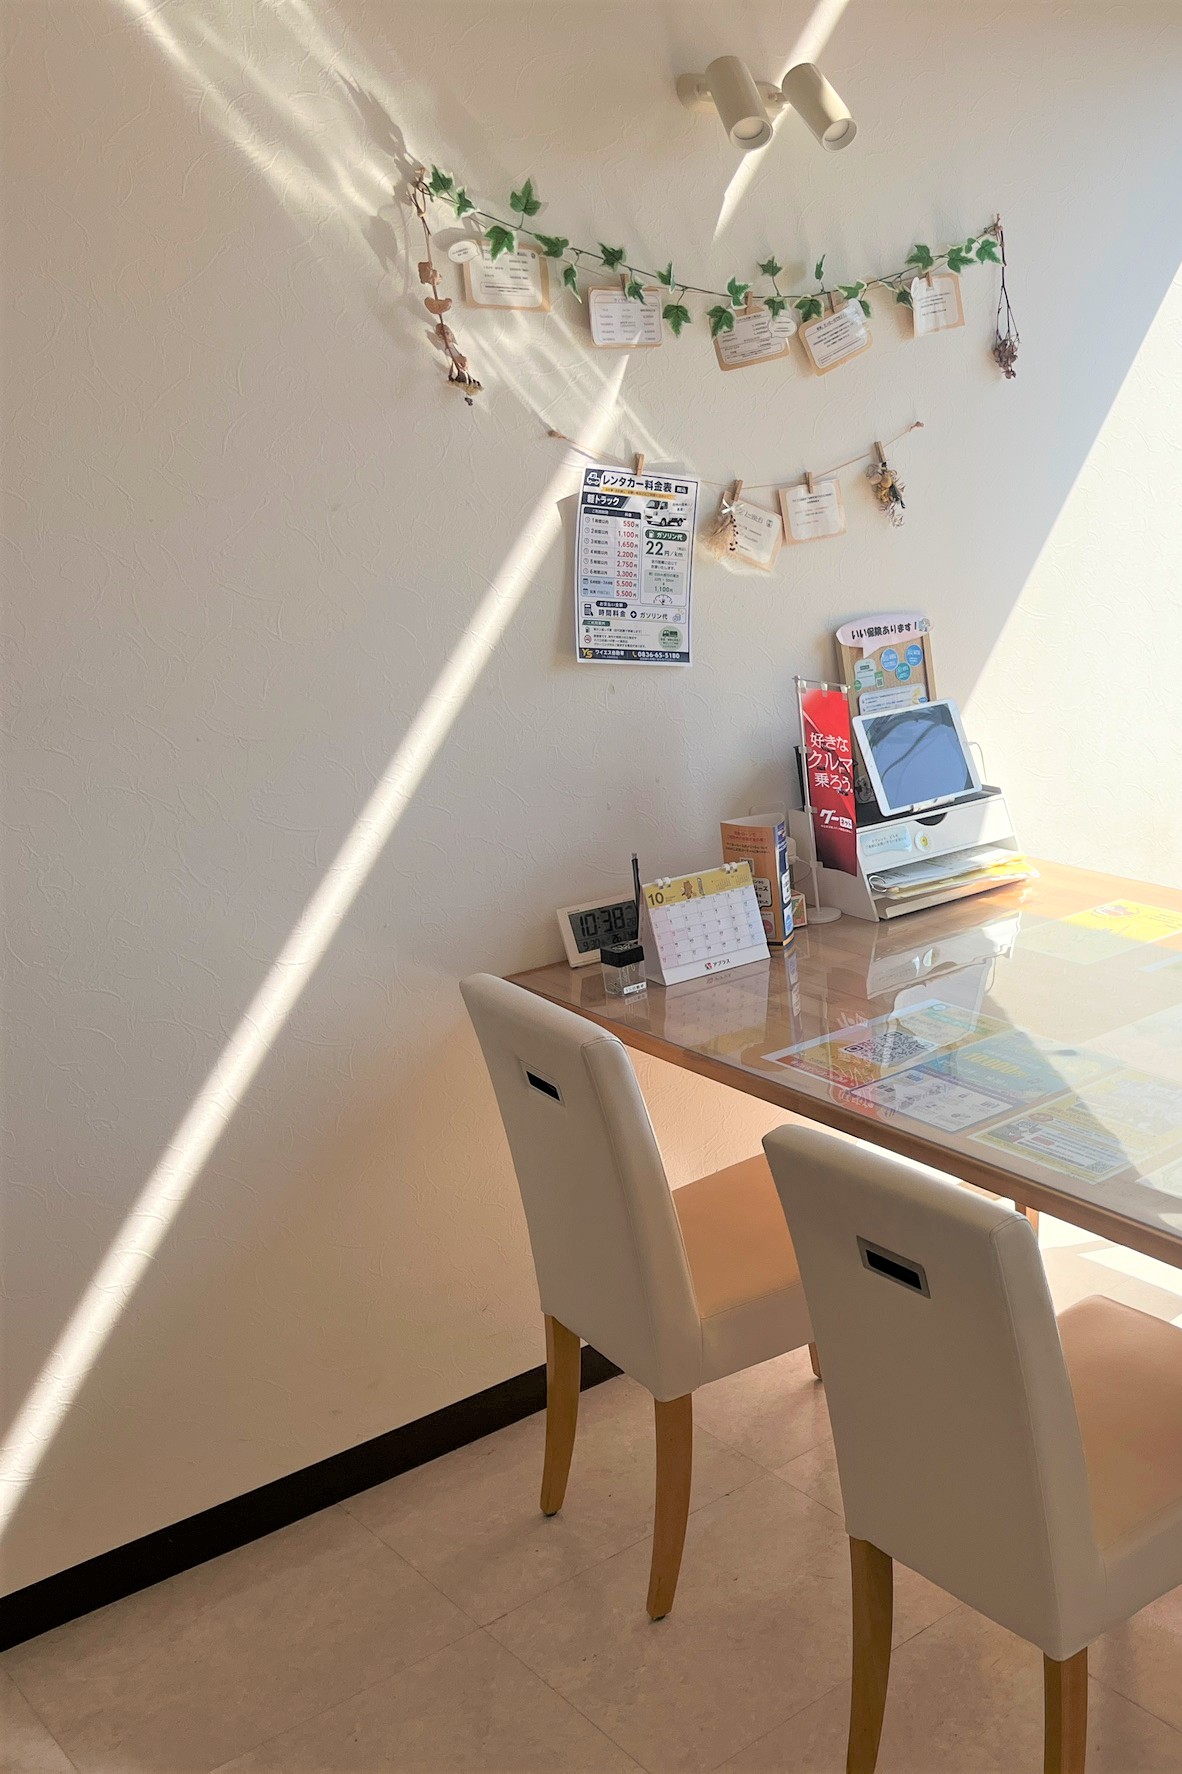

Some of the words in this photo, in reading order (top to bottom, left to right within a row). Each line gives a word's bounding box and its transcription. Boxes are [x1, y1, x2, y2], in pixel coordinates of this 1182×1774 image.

[602, 475, 672, 493] レンタカー料金表
[587, 494, 620, 506] 軽トラック
[656, 532, 683, 541] ガソリン代
[598, 609, 626, 617] 時間料金
[640, 612, 668, 620] ガソリン代
[582, 648, 593, 658] YS
[637, 651, 680, 659] 0836-65-5180
[810, 732, 849, 752] 好きな
[808, 750, 853, 773] クルマ
[648, 892, 664, 906] 10
[580, 907, 625, 937] 10:38
